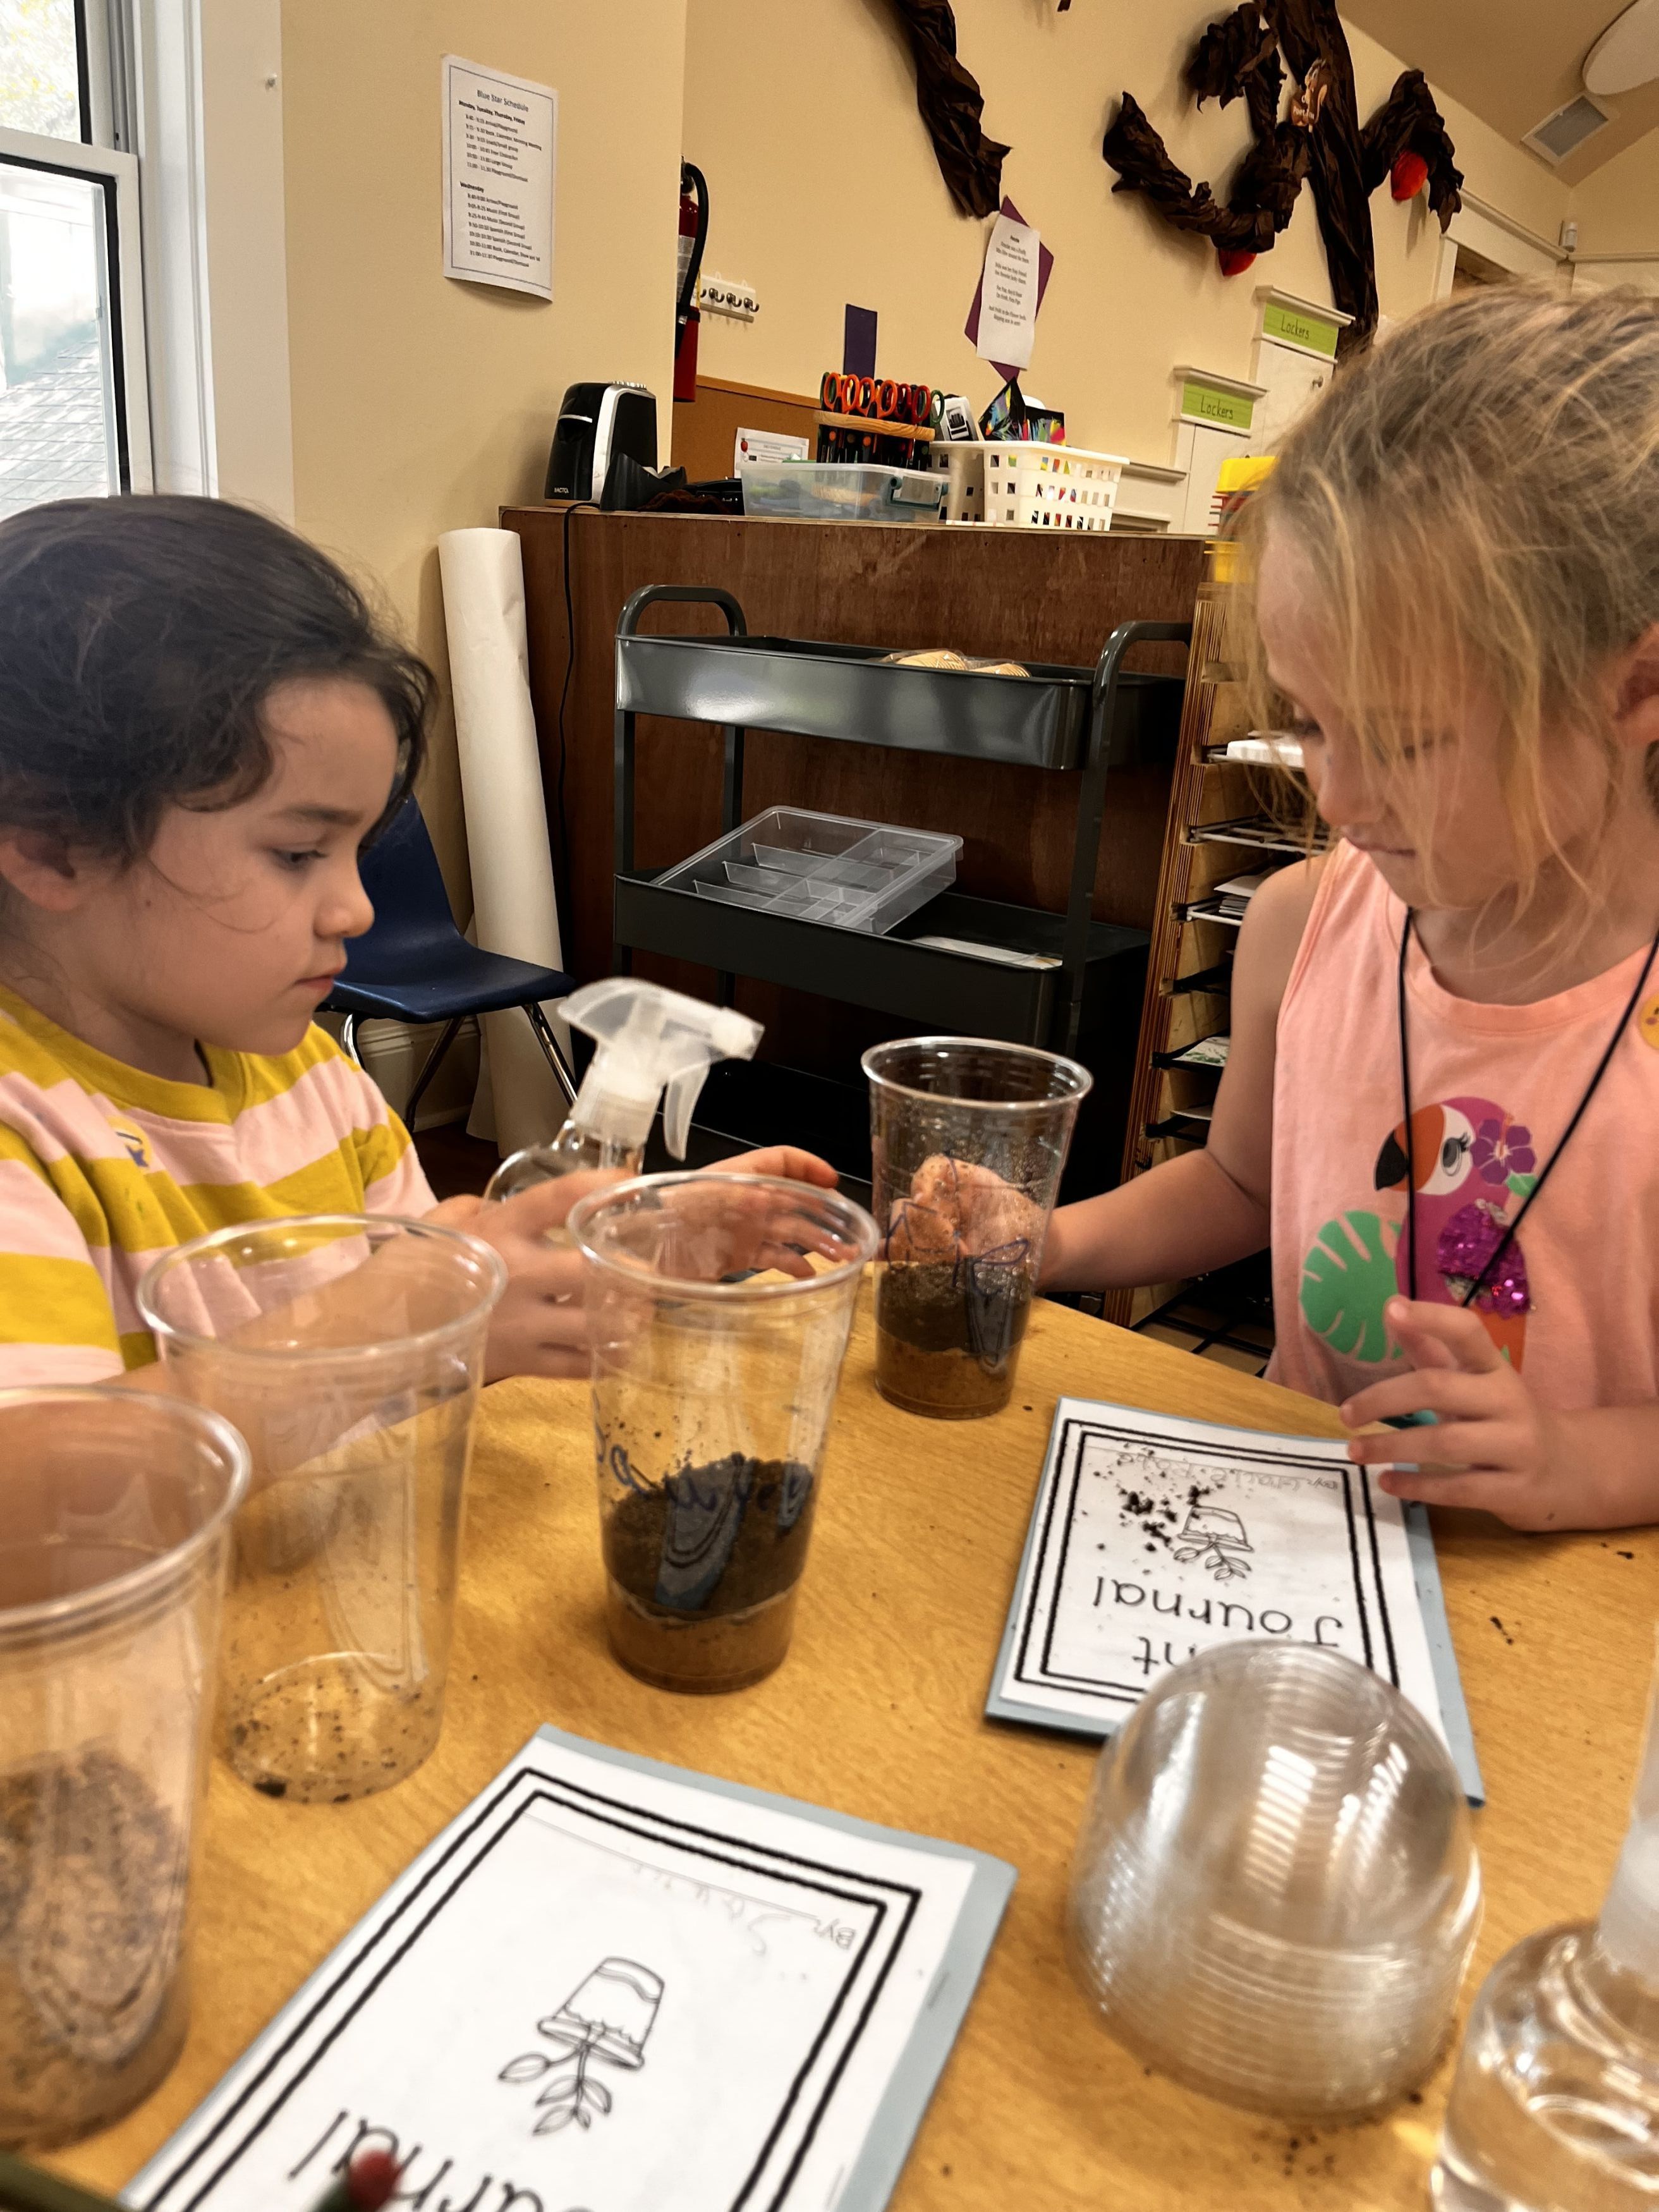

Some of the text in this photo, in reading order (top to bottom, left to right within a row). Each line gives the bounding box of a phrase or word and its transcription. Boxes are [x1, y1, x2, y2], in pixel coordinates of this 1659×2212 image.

[477, 90, 528, 112] Blue Star Schedule
[1281, 314, 1310, 339] Lockers
[1201, 395, 1233, 420] Lockers
[1093, 1576, 1344, 1648] Journal
[288, 2110, 592, 2212] urnal
